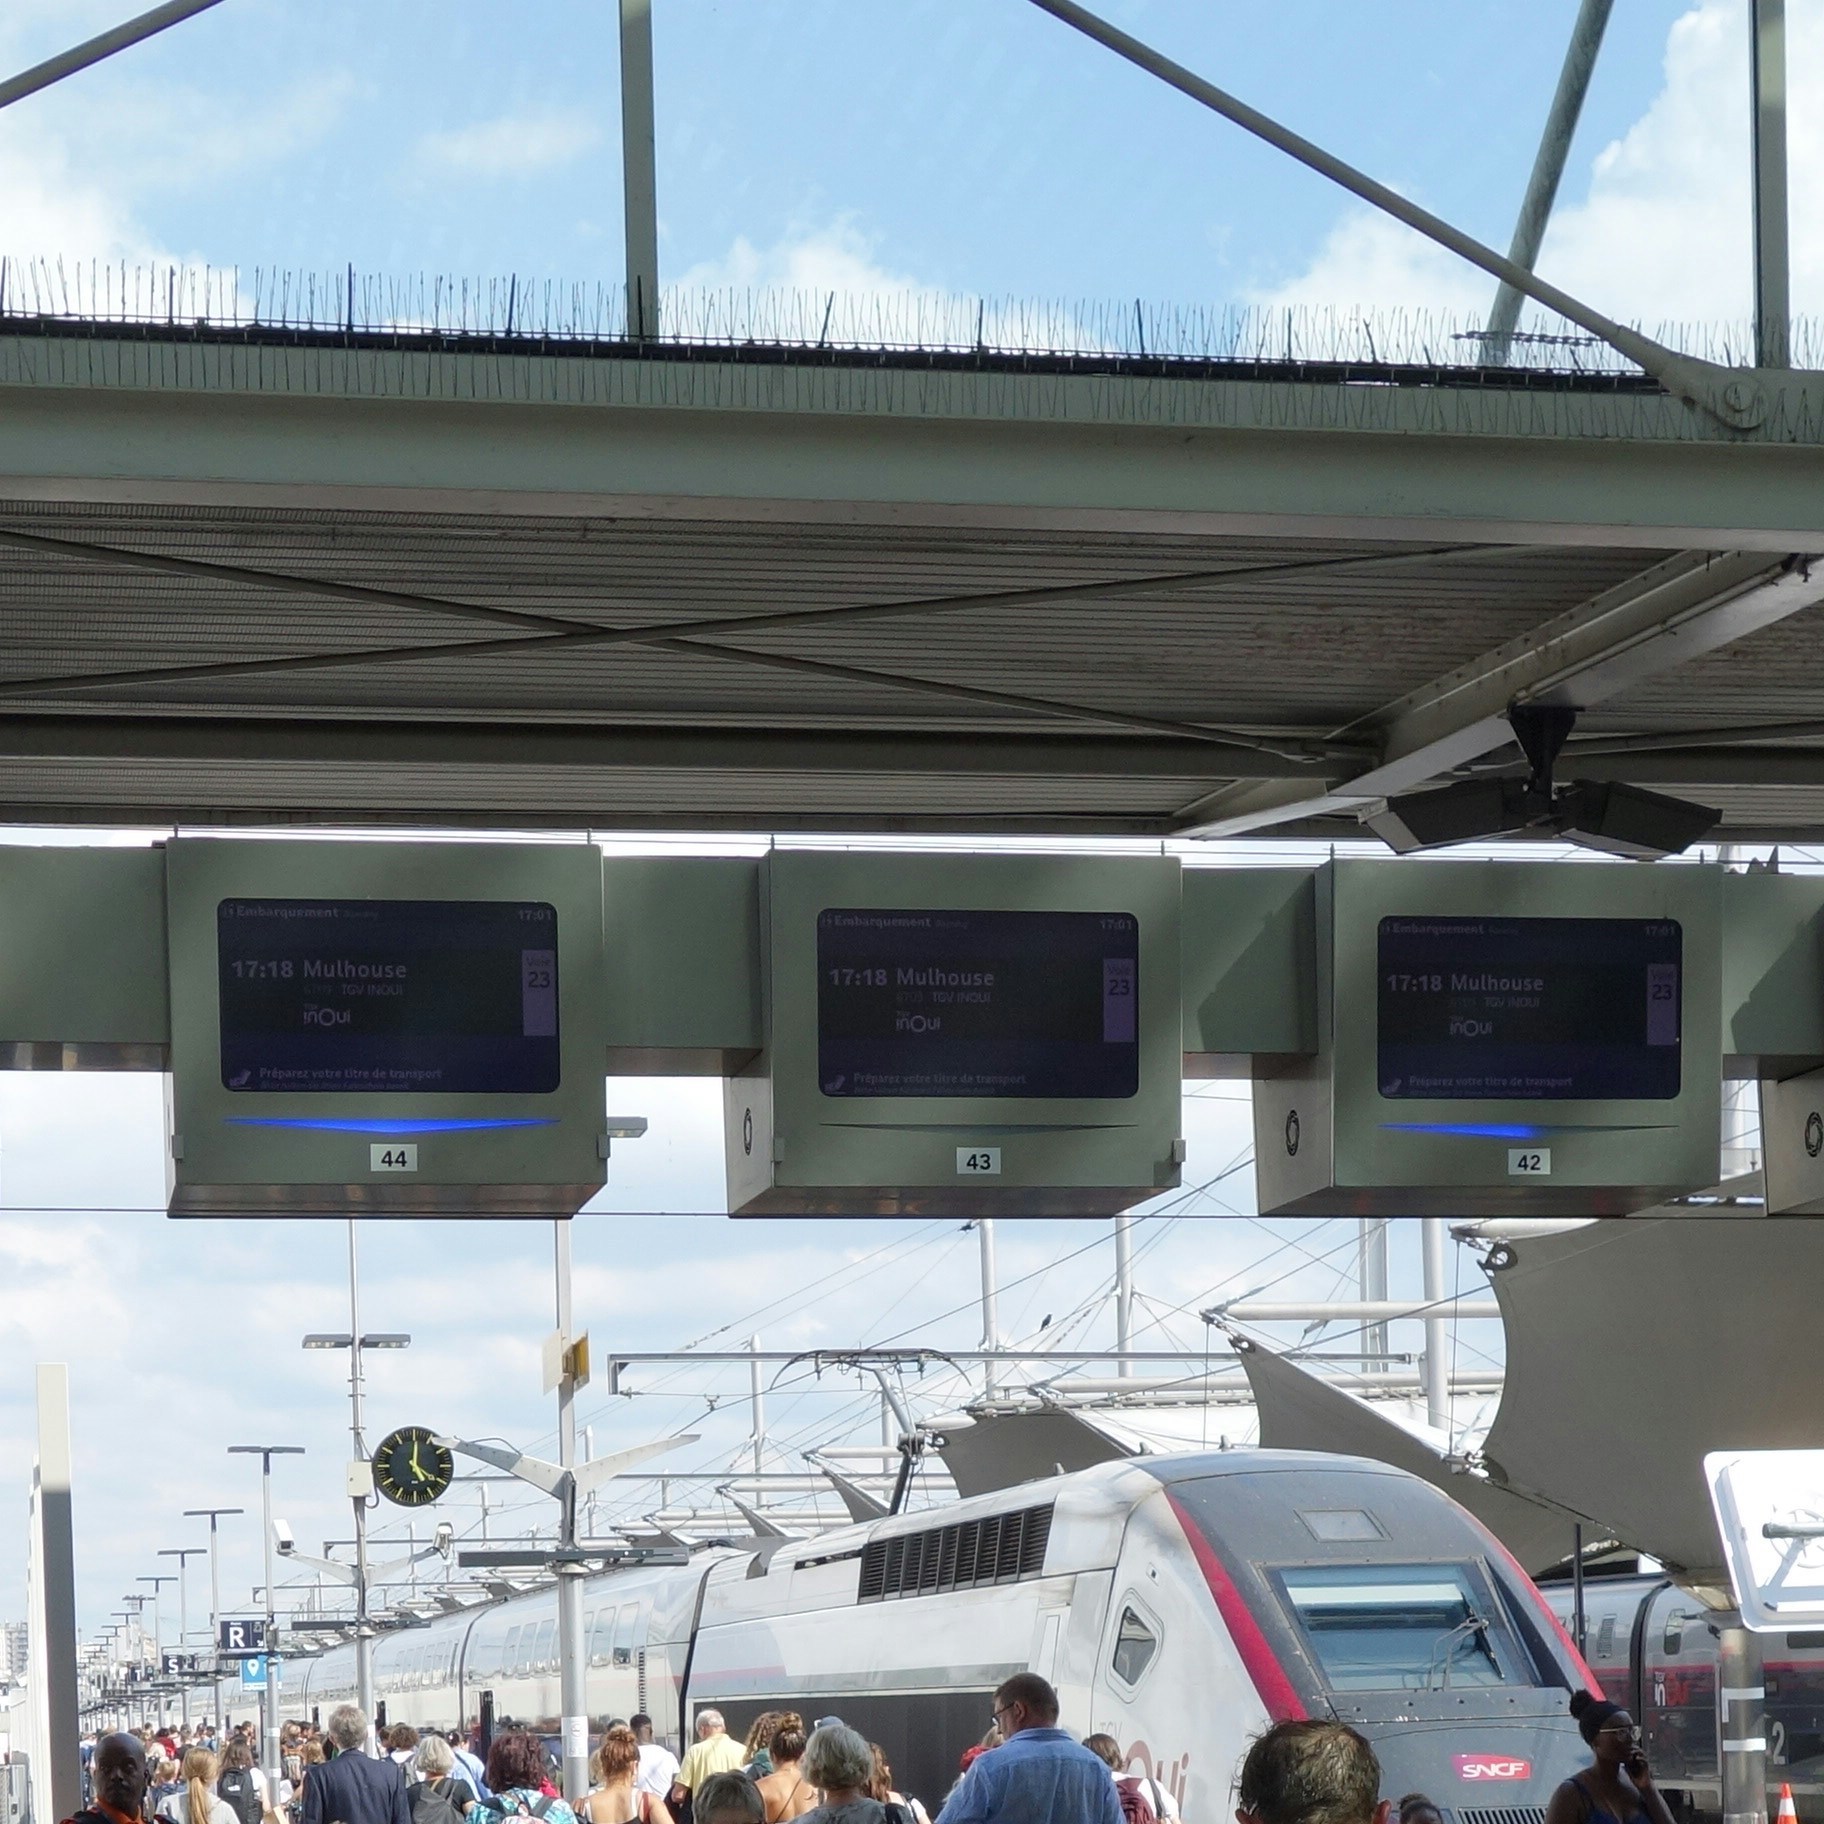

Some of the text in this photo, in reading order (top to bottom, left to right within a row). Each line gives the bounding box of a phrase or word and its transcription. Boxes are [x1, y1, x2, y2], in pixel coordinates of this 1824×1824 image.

[237, 905, 338, 919] Embarquement
[232, 960, 407, 979] 17:18 Mulhouse
[830, 968, 994, 986] 17:18 Mulhouse
[528, 972, 550, 988] 23
[1109, 980, 1130, 996] 23
[1387, 974, 1544, 992] 17:18 Mulhouse
[1652, 984, 1672, 1000] 23
[380, 1150, 408, 1168] 44
[966, 1153, 991, 1171] 43
[1517, 1154, 1541, 1171] 42
[229, 1626, 245, 1648] R
[168, 1658, 179, 1674] S
[1772, 1721, 1786, 1765] 2
[1462, 1763, 1525, 1778] SNCF
